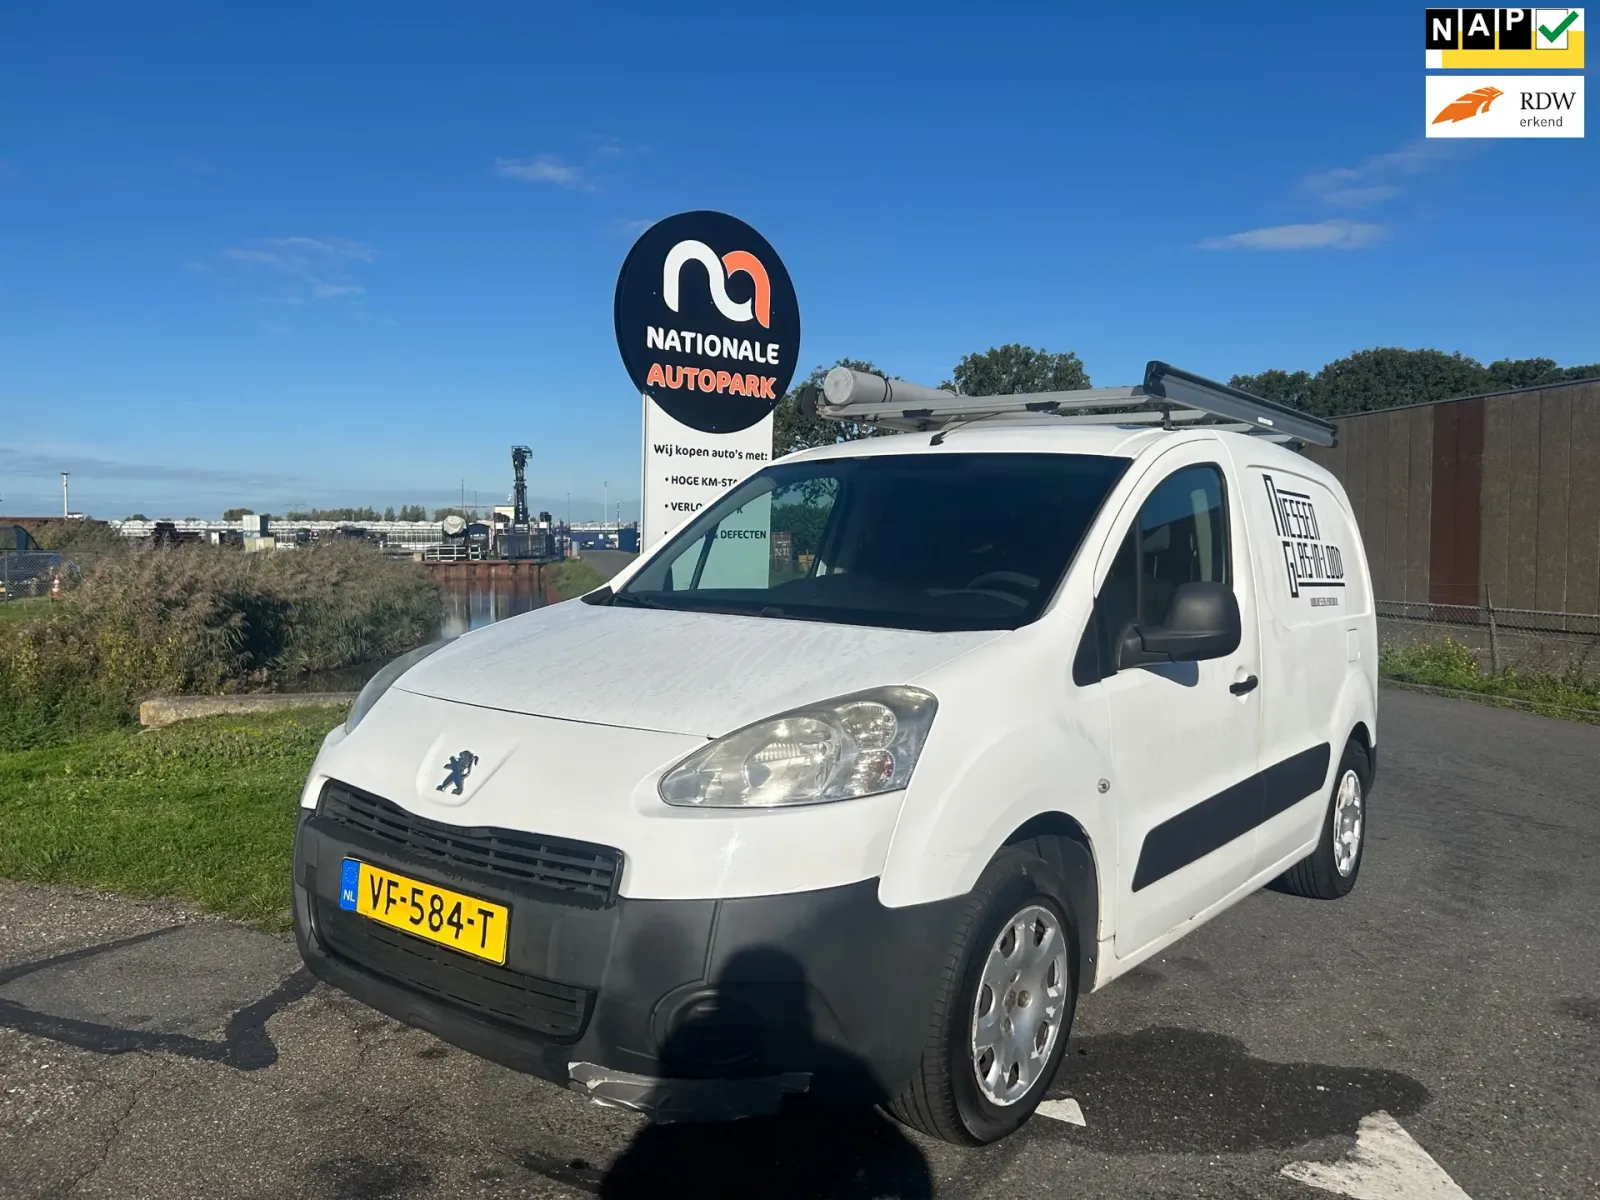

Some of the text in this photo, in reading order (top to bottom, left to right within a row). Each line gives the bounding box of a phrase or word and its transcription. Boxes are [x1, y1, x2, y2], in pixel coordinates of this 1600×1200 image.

[646, 325, 780, 365] NATIONALE
[646, 362, 777, 400] AUTOPARK
[653, 444, 768, 461] Wij kopen auto's met:
[671, 475, 700, 486] HOGE
[720, 530, 767, 539] DEFECTEN
[343, 873, 495, 949] NL VF-584-T
